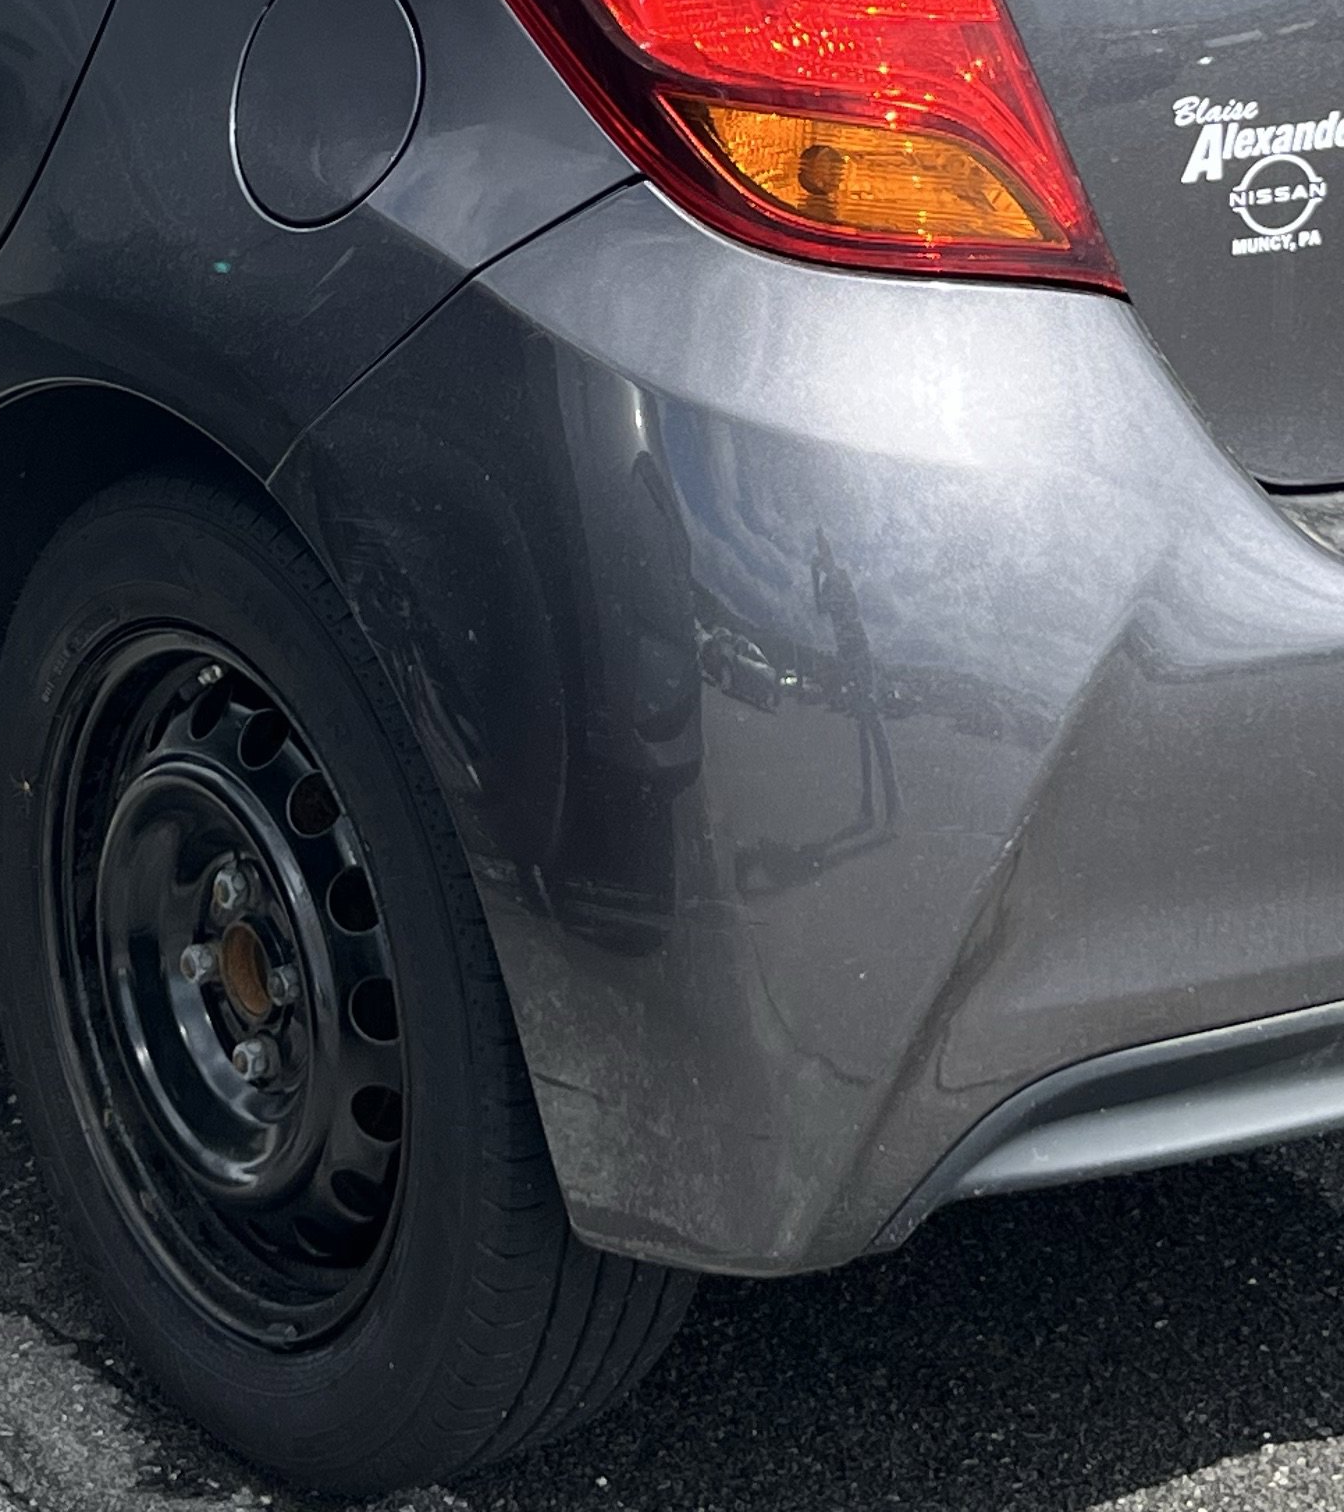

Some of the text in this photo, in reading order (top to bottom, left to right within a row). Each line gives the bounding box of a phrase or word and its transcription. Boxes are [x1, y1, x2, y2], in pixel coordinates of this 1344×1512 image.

[1172, 95, 1259, 127] Blaise
[1229, 182, 1327, 207] NISSAN
[1231, 229, 1322, 256] MUNCY, PA
